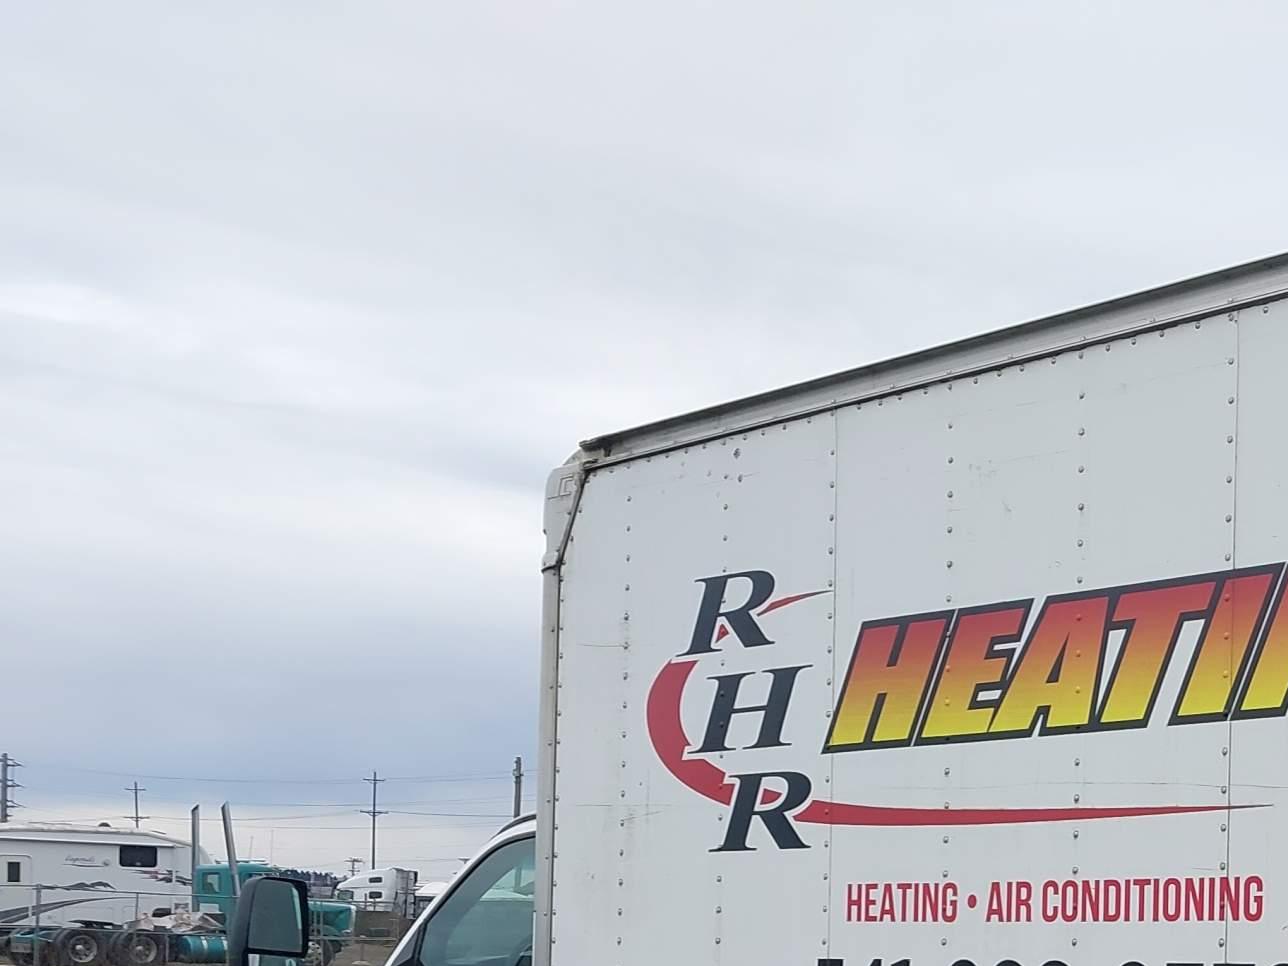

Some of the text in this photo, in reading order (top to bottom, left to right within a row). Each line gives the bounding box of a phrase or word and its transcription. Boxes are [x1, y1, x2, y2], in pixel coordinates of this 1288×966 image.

[846, 882, 958, 923] HEATING
[985, 881, 1033, 923] AIR
[1042, 875, 1264, 923] CONDITIONING
